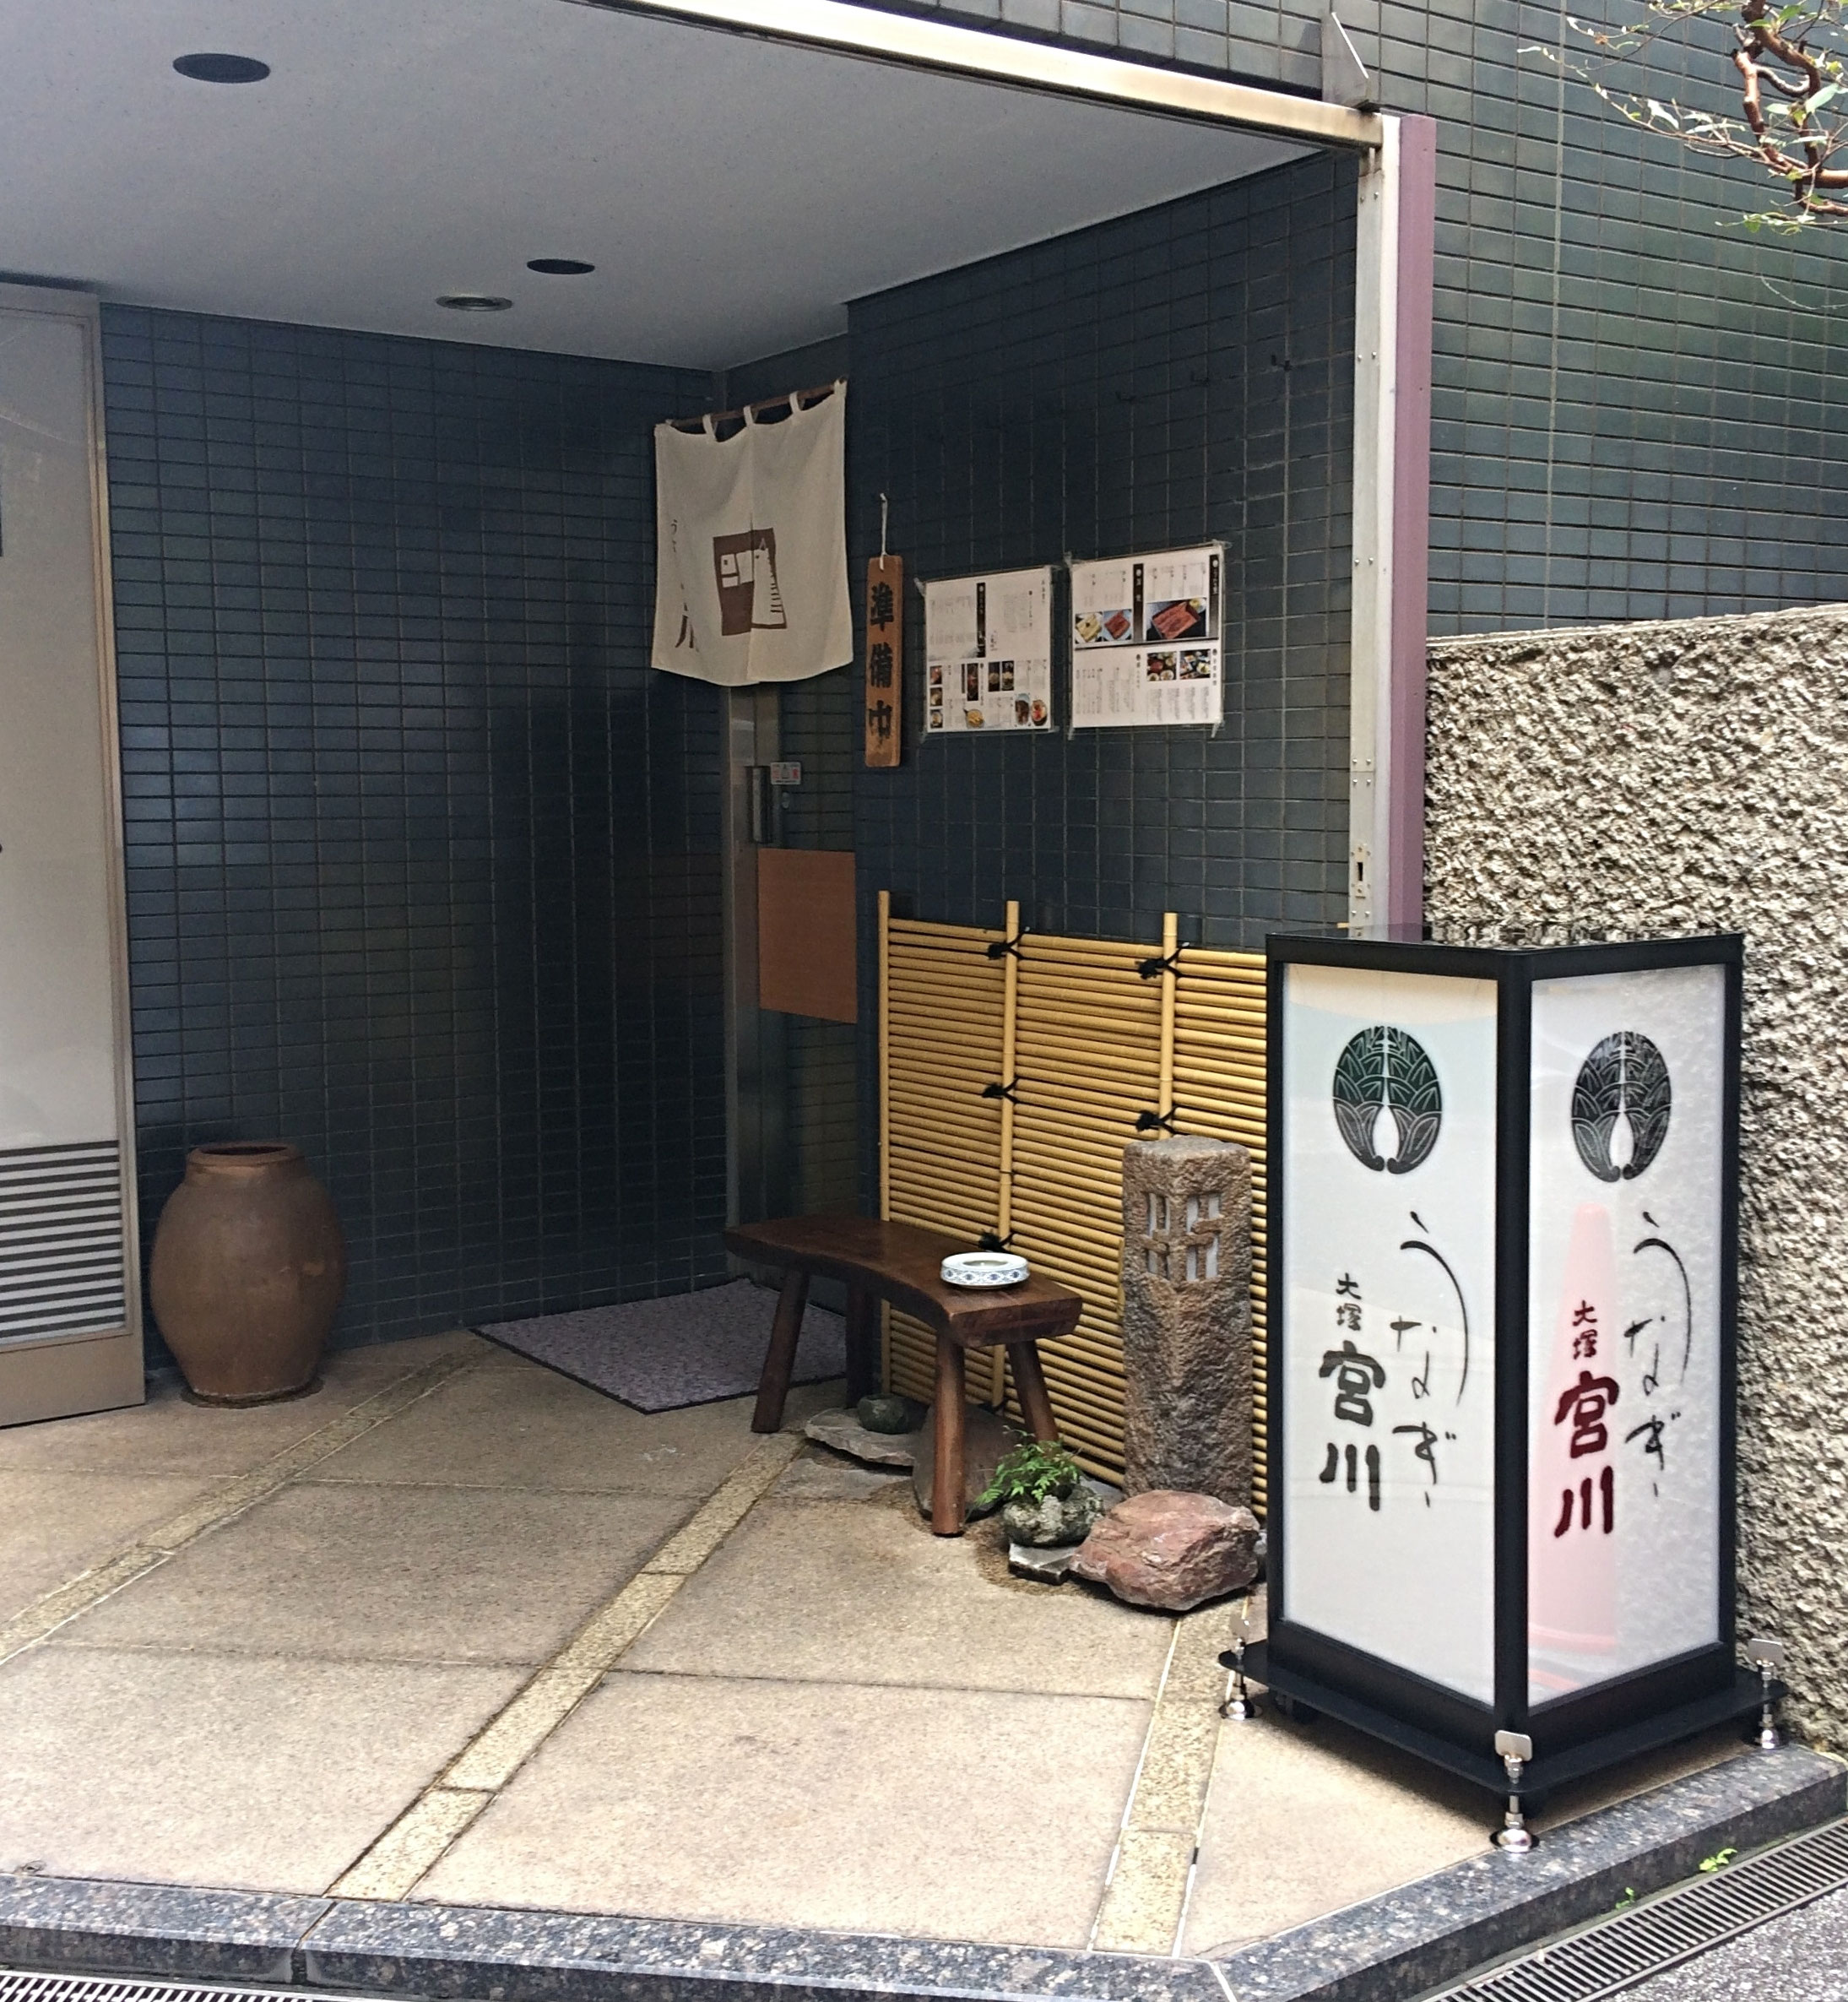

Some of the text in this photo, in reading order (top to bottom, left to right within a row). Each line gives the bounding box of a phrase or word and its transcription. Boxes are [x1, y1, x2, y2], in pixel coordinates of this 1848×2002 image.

[870, 581, 895, 746] 準備中
[1390, 1211, 1469, 1507] うなぎ
[1624, 1211, 1692, 1497] うなぎ
